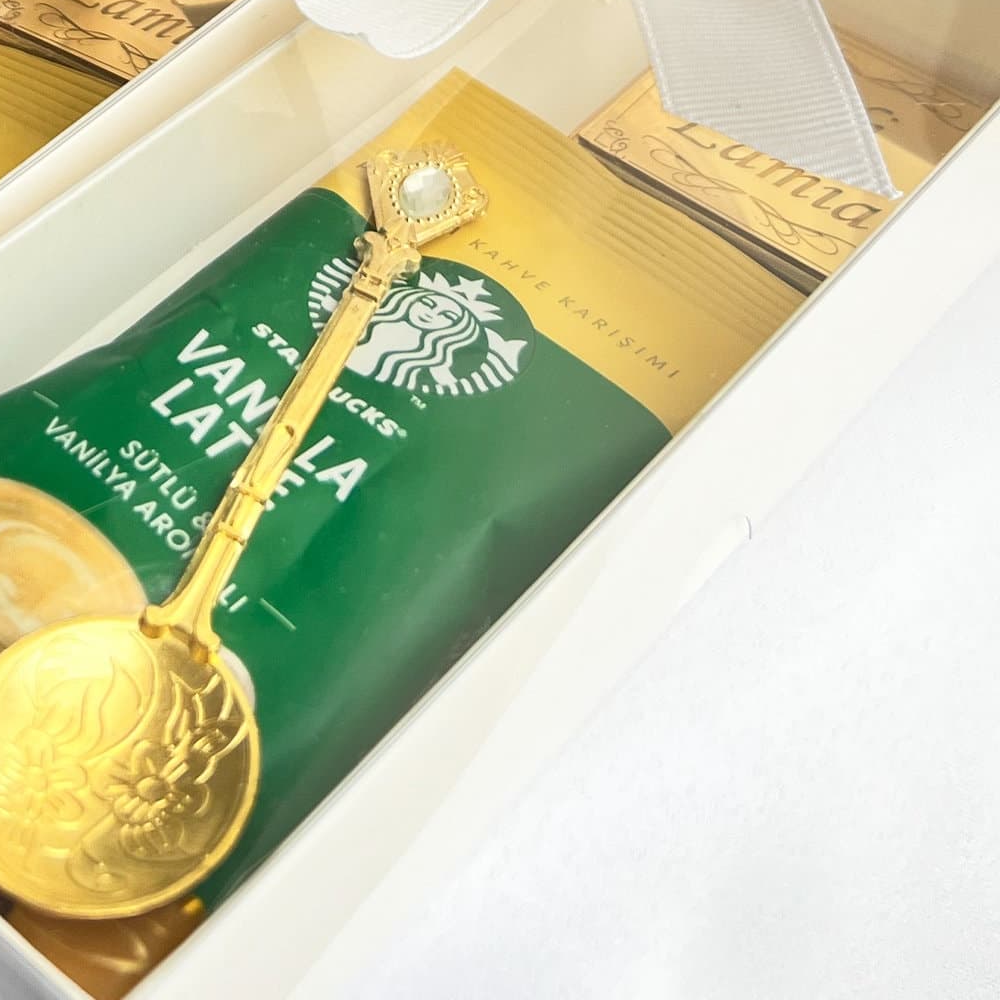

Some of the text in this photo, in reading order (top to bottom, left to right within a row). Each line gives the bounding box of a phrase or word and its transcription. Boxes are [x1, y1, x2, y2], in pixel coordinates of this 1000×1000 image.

[468, 238, 680, 378] KAHVE KARIŞIMI
[119, 440, 198, 510] SÜTLÜ
[150, 378, 305, 511] LATE
[177, 328, 368, 502] VANLA
[45, 416, 248, 612] VANİLYA AROLI
